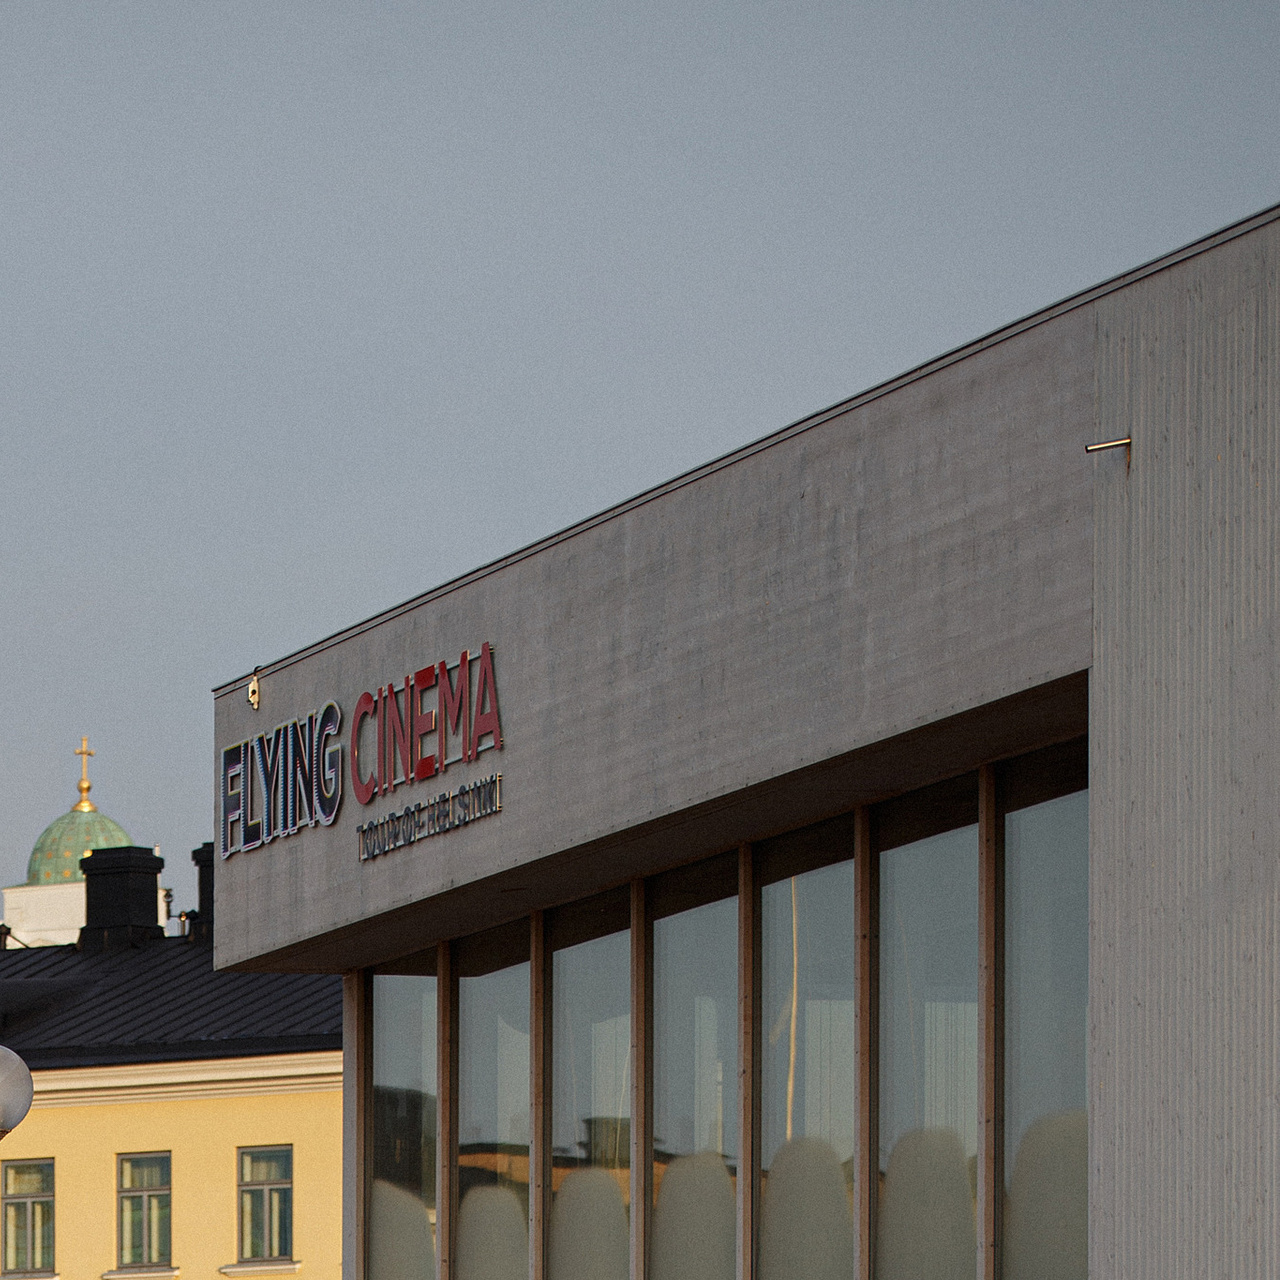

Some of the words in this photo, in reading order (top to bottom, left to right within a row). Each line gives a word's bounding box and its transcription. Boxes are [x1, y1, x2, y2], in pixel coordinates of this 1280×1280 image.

[221, 700, 341, 860] FLYING
[350, 642, 502, 805] CINEMA
[356, 812, 400, 862] TOUR
[402, 802, 425, 844] OF
[427, 772, 502, 835] HELSINKI
